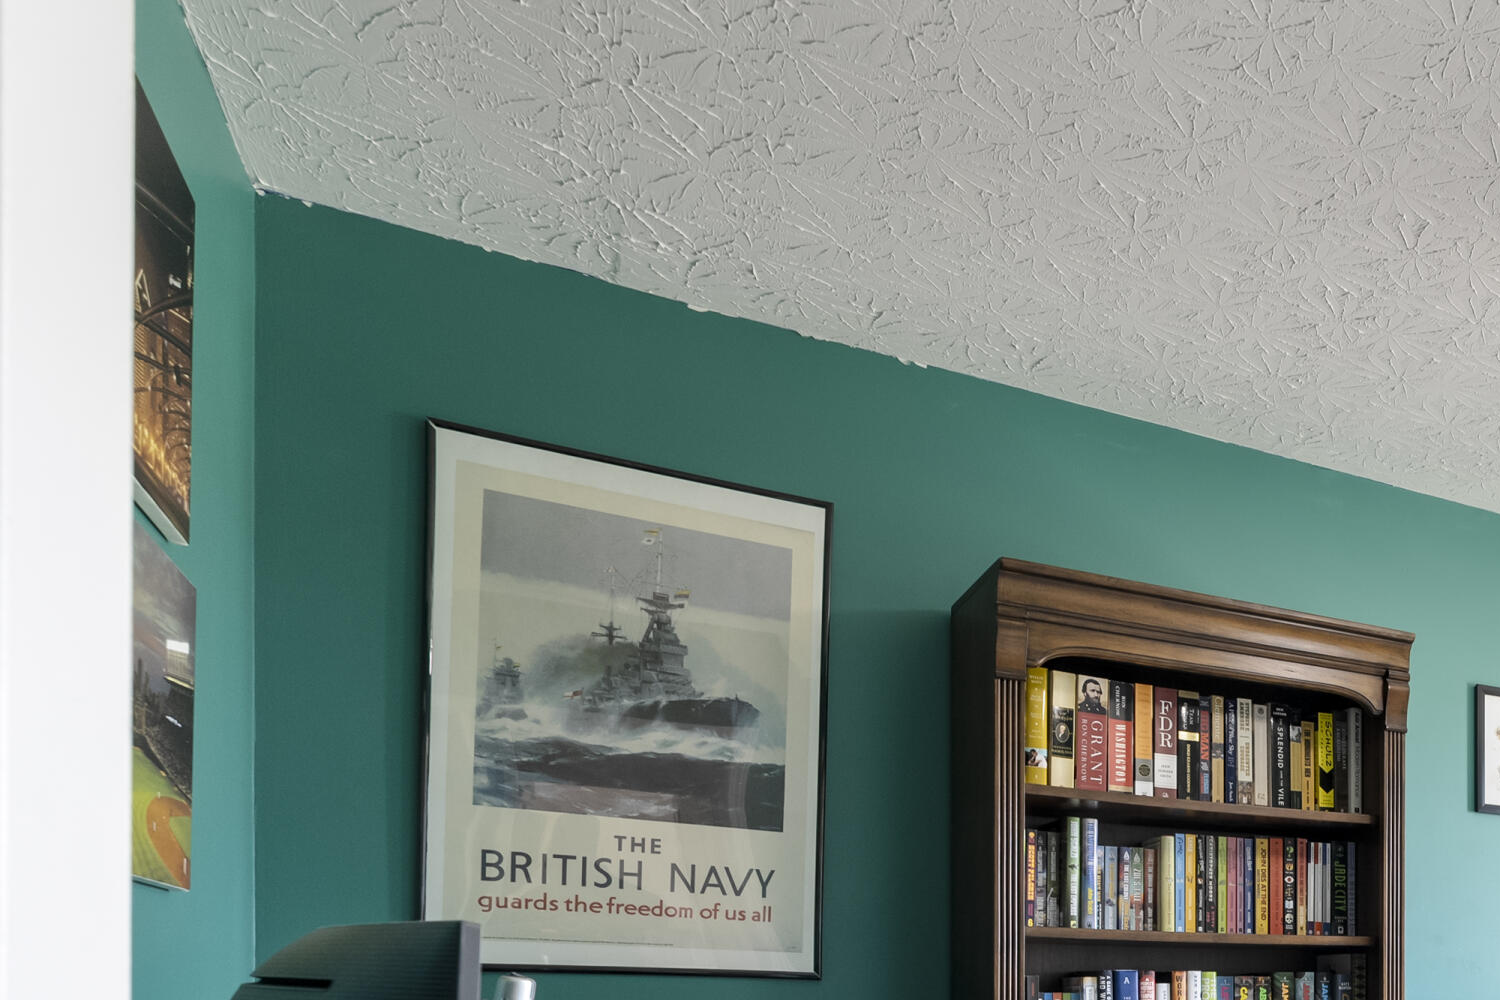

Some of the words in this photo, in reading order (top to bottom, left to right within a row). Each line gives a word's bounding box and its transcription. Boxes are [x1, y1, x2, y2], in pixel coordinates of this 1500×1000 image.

[1160, 700, 1173, 748] FDR
[1090, 720, 1104, 785] GRANT
[1114, 724, 1127, 782] WASHINGTON
[614, 835, 662, 855] THE
[480, 848, 643, 891] BRITISH
[670, 863, 775, 899] NAVY
[1261, 884, 1266, 892] AT
[1334, 861, 1346, 888] JADE
[478, 892, 560, 914] guards
[565, 895, 603, 915] the
[607, 897, 694, 920] freedom
[700, 901, 723, 921] of
[725, 907, 746, 922] us
[751, 905, 772, 923] all
[1335, 890, 1346, 912] CITY
